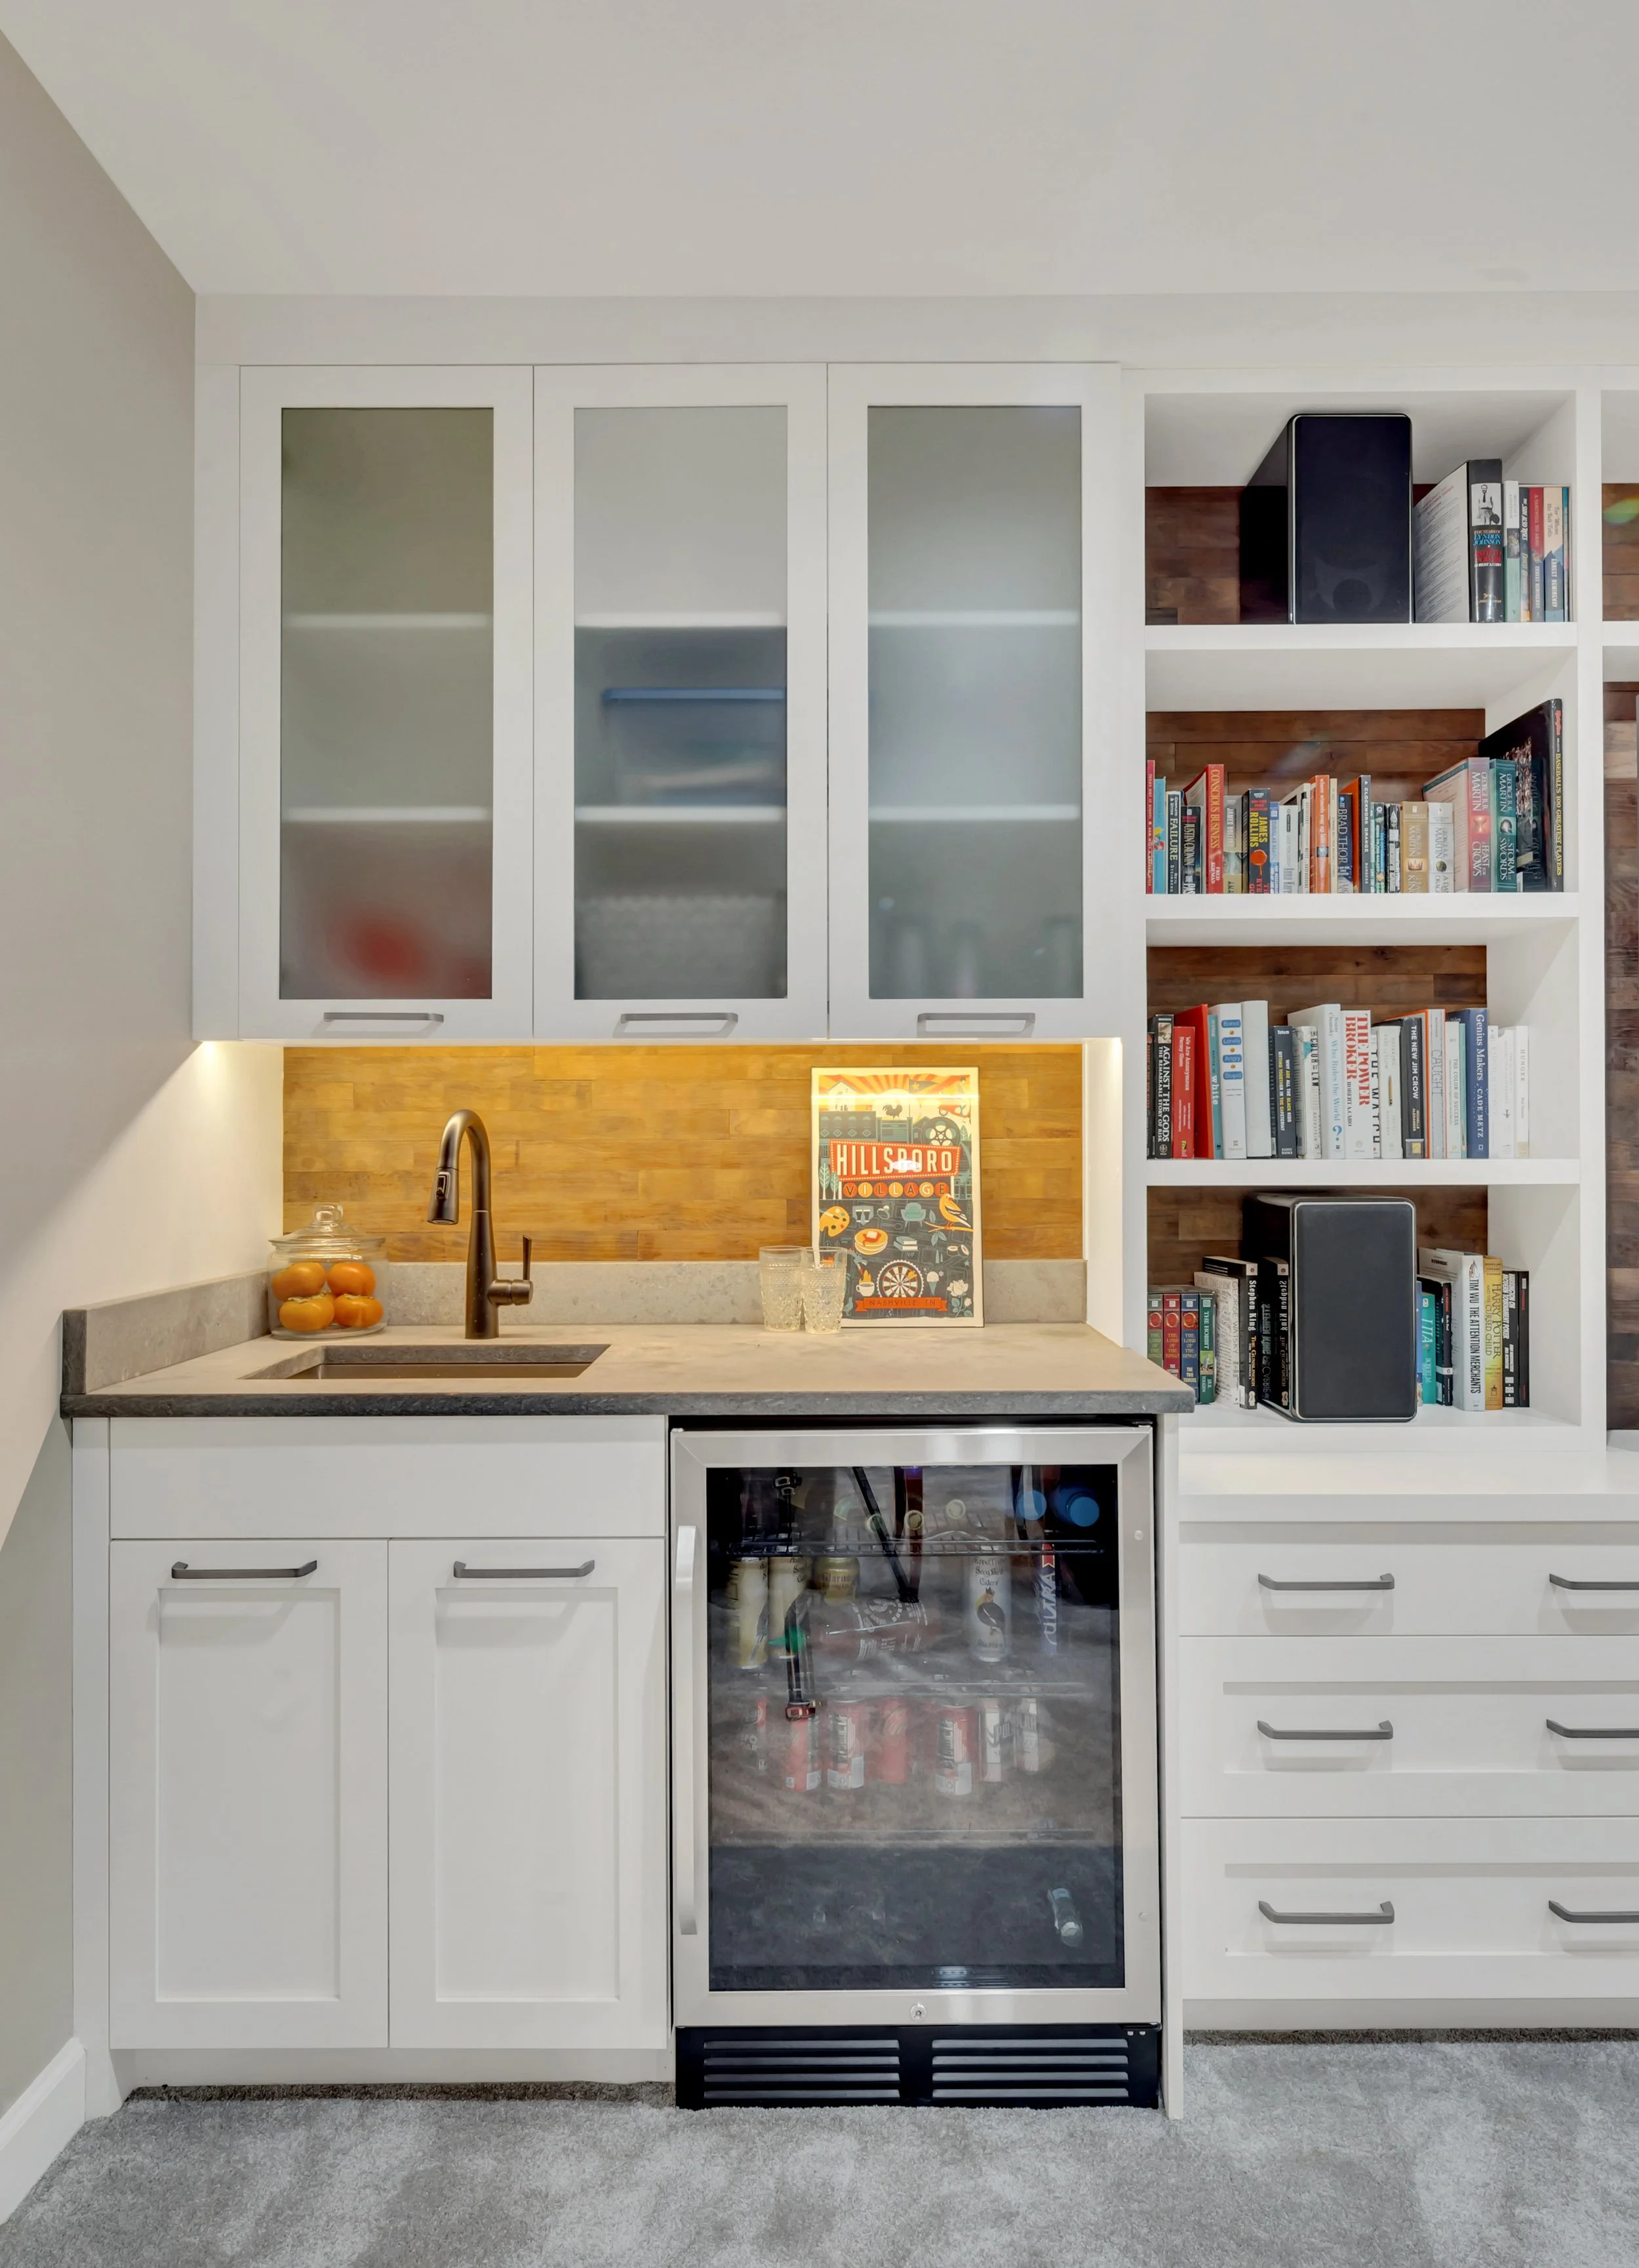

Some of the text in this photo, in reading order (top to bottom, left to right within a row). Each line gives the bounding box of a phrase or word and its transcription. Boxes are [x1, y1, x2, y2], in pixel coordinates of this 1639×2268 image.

[1210, 770, 1220, 848] CONSCIOUS BUSINESS
[1472, 772, 1482, 811] MARTIN
[1184, 824, 1195, 865] JUSTIN CRONIN
[1250, 812, 1259, 848] ROLLINS
[1259, 816, 1268, 842] JAMES
[1338, 809, 1348, 863] BRAD THOR
[1284, 868, 1295, 880] Anna
[1472, 841, 1482, 876] CROWS
[1185, 1036, 1191, 1046] We
[1345, 1017, 1357, 1080] BROKER
[1475, 1014, 1484, 1046] Genius
[1357, 1014, 1370, 1106] THE POWER
[1431, 1049, 1442, 1097] CAUGHT
[1476, 1049, 1485, 1080] Makers
[1158, 1119, 1162, 1127] OF
[837, 1144, 952, 1175] HILLSBORO
[846, 1184, 945, 1196] VILLAGE
[1248, 1280, 1256, 1331] Stephen King
[1492, 1283, 1501, 1319] HARRY
[1469, 1279, 1481, 1394] TIM WU THE ATTENTION MERCHANTS
[1493, 1321, 1501, 1359] POTTER
[1040, 1573, 1057, 1645] ULTRA
